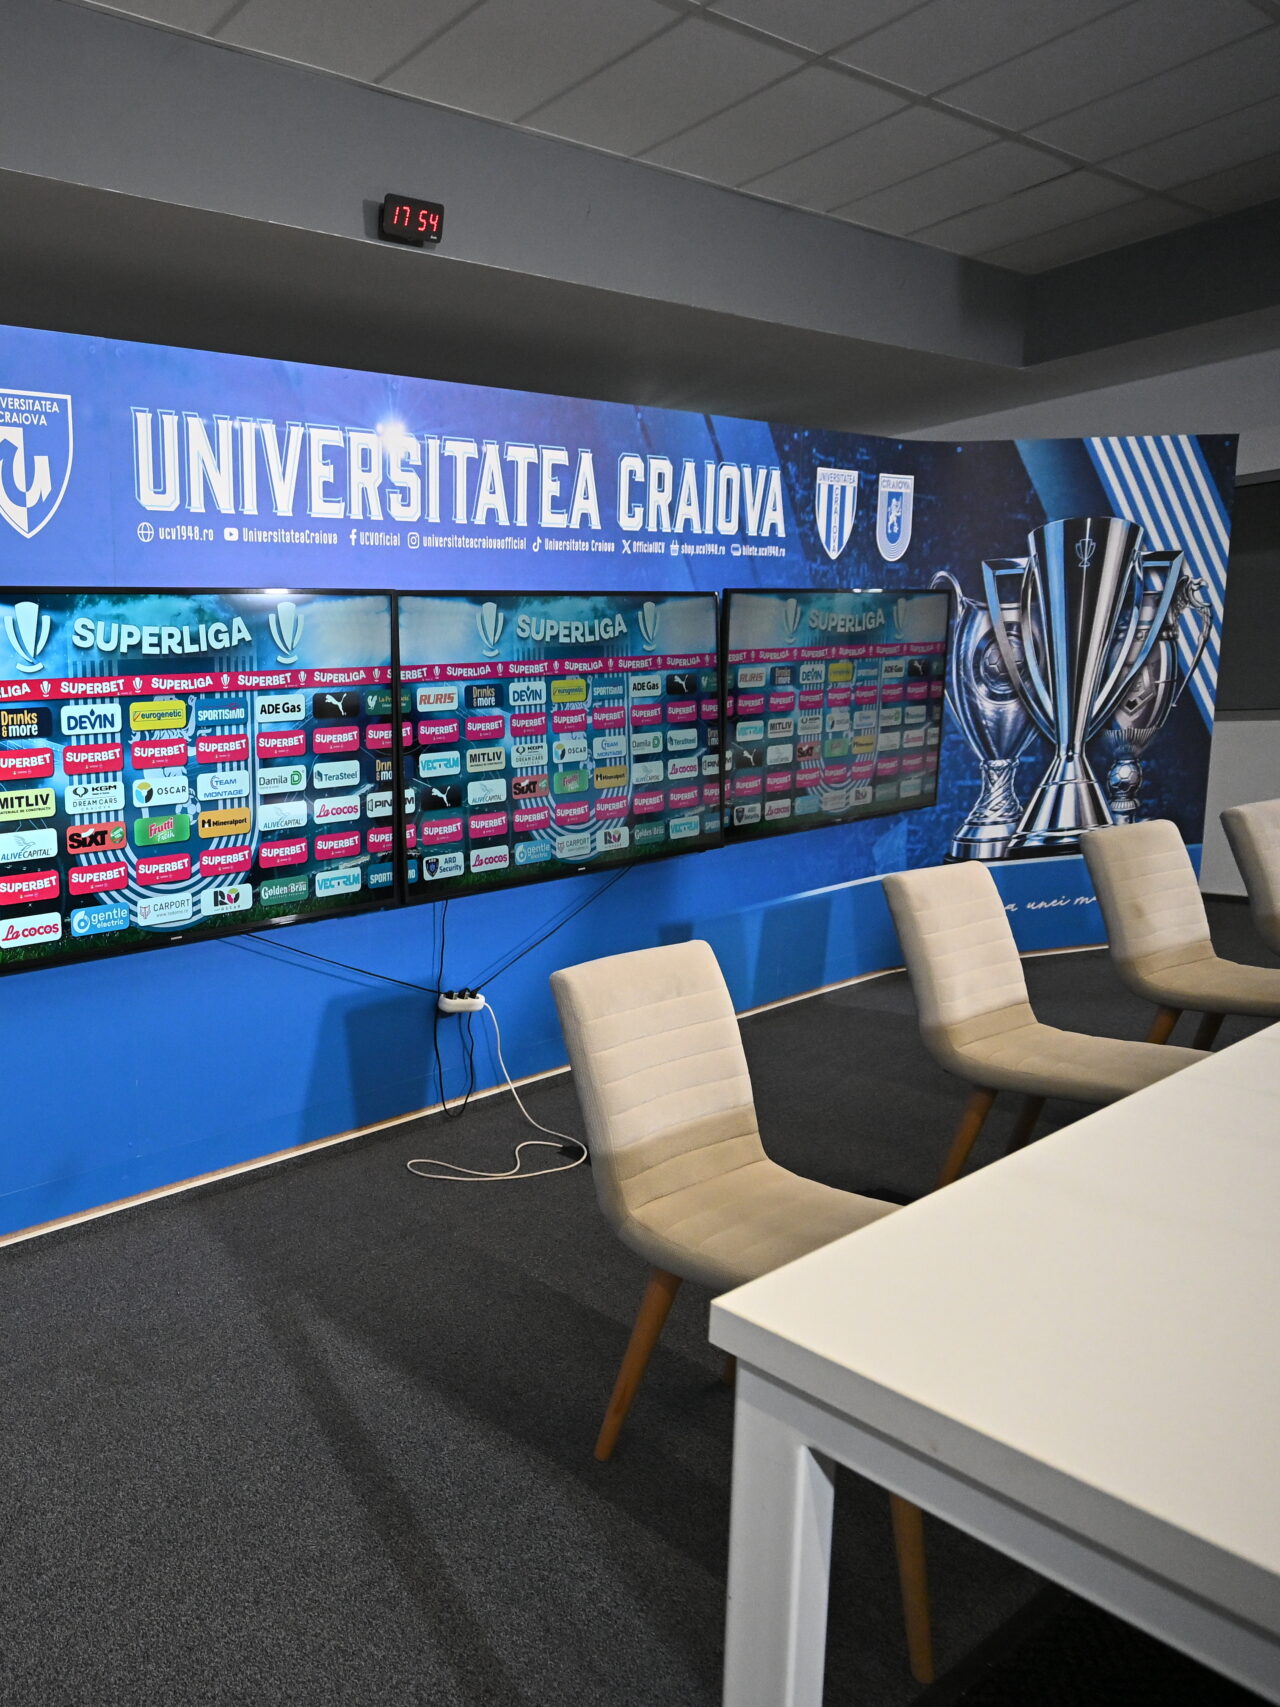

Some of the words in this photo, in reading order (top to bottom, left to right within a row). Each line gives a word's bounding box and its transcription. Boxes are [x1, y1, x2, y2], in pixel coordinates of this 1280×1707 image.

[393, 206, 410, 227] 17
[417, 209, 439, 232] 54
[131, 406, 601, 529] UNIVERSITATEA
[617, 452, 787, 538] CRAIOVA
[159, 526, 214, 541] ucv1948.ro
[243, 527, 338, 545] UniversitateaCraiova
[423, 532, 527, 550] universitateacraiovaofficial
[544, 539, 589, 552] Universitatea
[591, 540, 615, 553] Craiova
[808, 608, 885, 633] SUPERLIGA
[516, 613, 627, 644] SUPERLIGA
[71, 616, 252, 655] SUPERLIGA
[446, 664, 491, 677] SUPERLIGA
[508, 662, 549, 675] SUPERBET
[564, 659, 603, 672] SUPERLIGA
[618, 657, 653, 669] SUPERBET
[666, 655, 700, 667] SUPERLIGA
[60, 679, 125, 695] SUPERBET
[151, 676, 213, 691] SUPERLIGA
[237, 673, 292, 687] SUPERBET
[313, 670, 366, 684] SUPERLIGA
[802, 671, 822, 682] DEVIN
[472, 685, 496, 699] Drinks
[632, 682, 646, 691] ADE
[646, 681, 659, 690] Gas
[419, 692, 456, 705] RURIS
[512, 689, 542, 702] DEVIN
[140, 708, 183, 721] eurogenetic
[260, 703, 281, 715] ADE
[281, 702, 301, 714] Gas
[632, 708, 661, 718] SUPERBET
[668, 705, 696, 714] SUPERBET
[0, 710, 38, 725] Drinks
[67, 713, 115, 730] DEVIN
[511, 716, 546, 728] SUPERBET
[553, 713, 586, 724] SUPERBET
[593, 711, 624, 721] SUPERBET
[420, 723, 458, 735] SUPERBET
[467, 720, 503, 732] SUPERBET
[258, 735, 304, 748] SUPERBET
[315, 731, 358, 743] SUPERBET
[134, 743, 186, 758] SUPERBET
[198, 740, 247, 753] SUPERBET
[65, 748, 121, 763] SUPERBET
[470, 751, 502, 762] MITLIV
[214, 778, 237, 786] TEAM
[259, 775, 288, 786] Damila
[324, 771, 358, 782] TeraSteel
[91, 784, 117, 792] KGM
[156, 786, 187, 796] OSCAR
[204, 789, 243, 798] MONTAGE
[634, 795, 663, 806] SUPERBET
[670, 790, 698, 801] SUPERBET
[72, 800, 98, 808] DREAM
[99, 797, 118, 805] CARS
[597, 801, 627, 811] SUPERBET
[515, 811, 549, 823] SUPERBET
[556, 806, 588, 817] SUPERBET
[149, 818, 174, 837] Frutti
[212, 817, 247, 828] Mineralport
[471, 816, 506, 829] SUPERBET
[424, 823, 462, 836] SUPERBET
[317, 836, 359, 850] SUPERBET
[1, 848, 51, 861] ALIVECAPITAL
[261, 843, 306, 858] SUPERBET
[202, 850, 250, 866] SUPERBET
[444, 856, 456, 864] ARD
[138, 859, 189, 874] SUPERBET
[439, 864, 462, 874] Security
[71, 866, 126, 883] SUPERBET
[0, 876, 57, 893] SUPERBET
[317, 873, 360, 890] VECTRUM
[261, 885, 286, 900] Golden
[153, 898, 190, 912] CARPORT
[91, 905, 128, 925] gentle
[97, 918, 124, 929] electric
